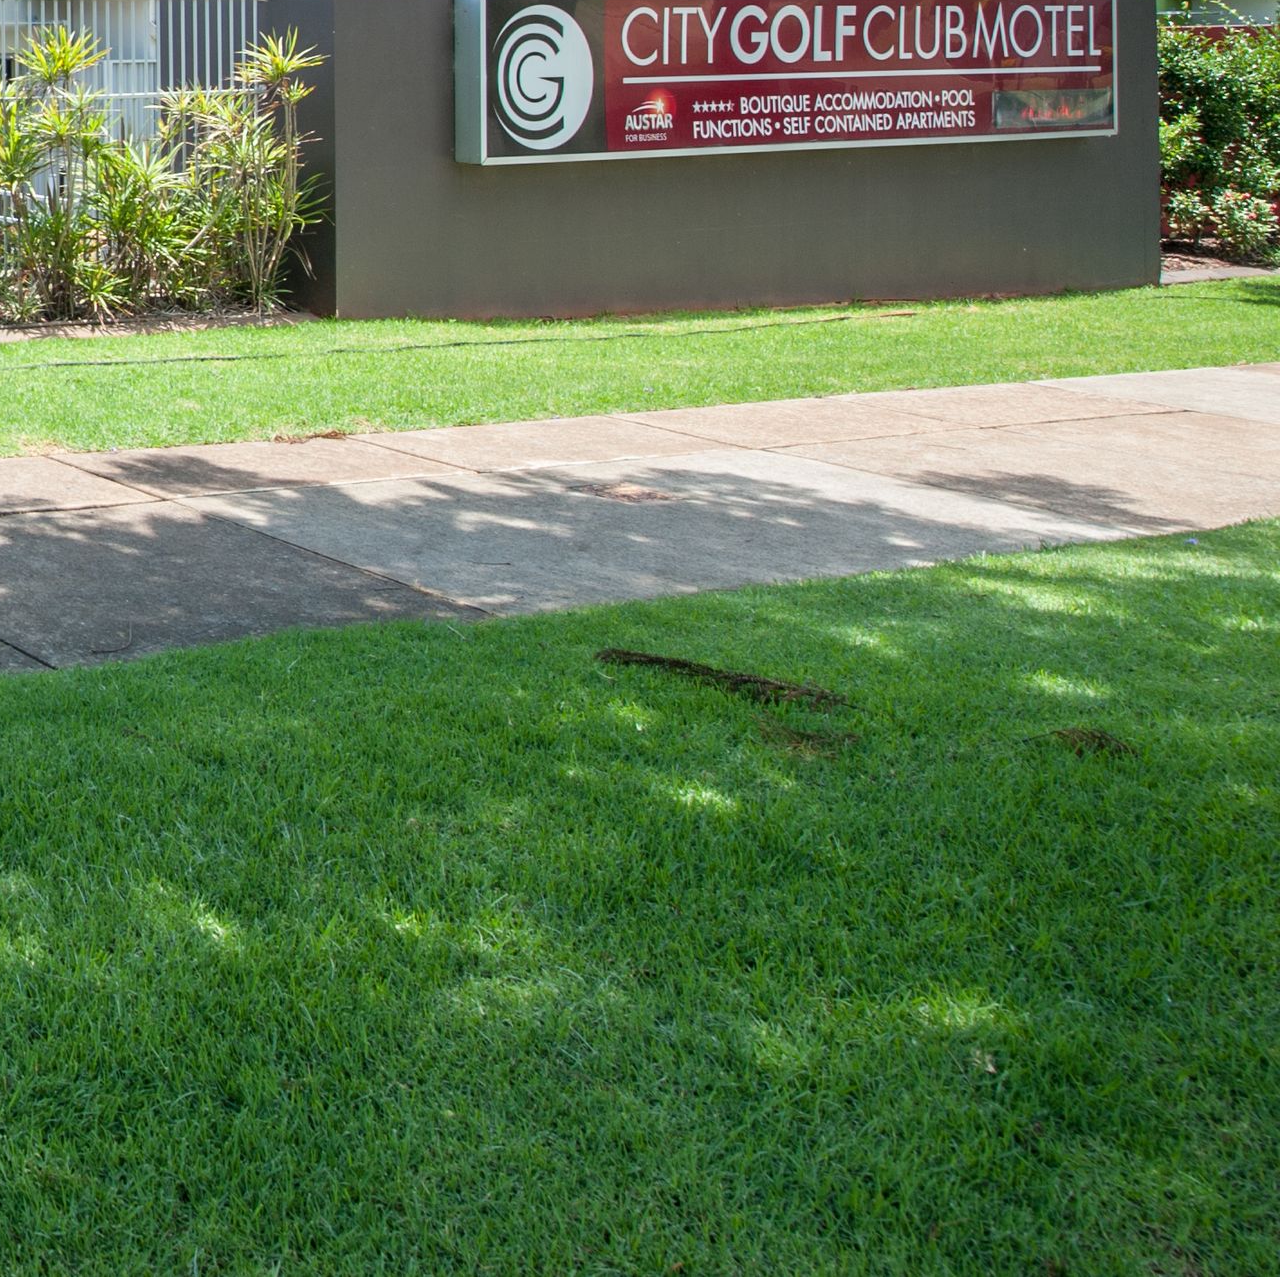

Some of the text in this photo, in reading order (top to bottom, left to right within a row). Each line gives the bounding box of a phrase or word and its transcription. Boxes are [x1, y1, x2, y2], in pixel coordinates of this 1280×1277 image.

[740, 89, 975, 114] BOUTIQUE ACCOMMODATION POOL
[624, 113, 673, 131] AUSTAR
[692, 110, 976, 139] FUNCTIONS SELF CONTAINED APARTMENTS
[625, 132, 668, 142] FOR BUSINESS
